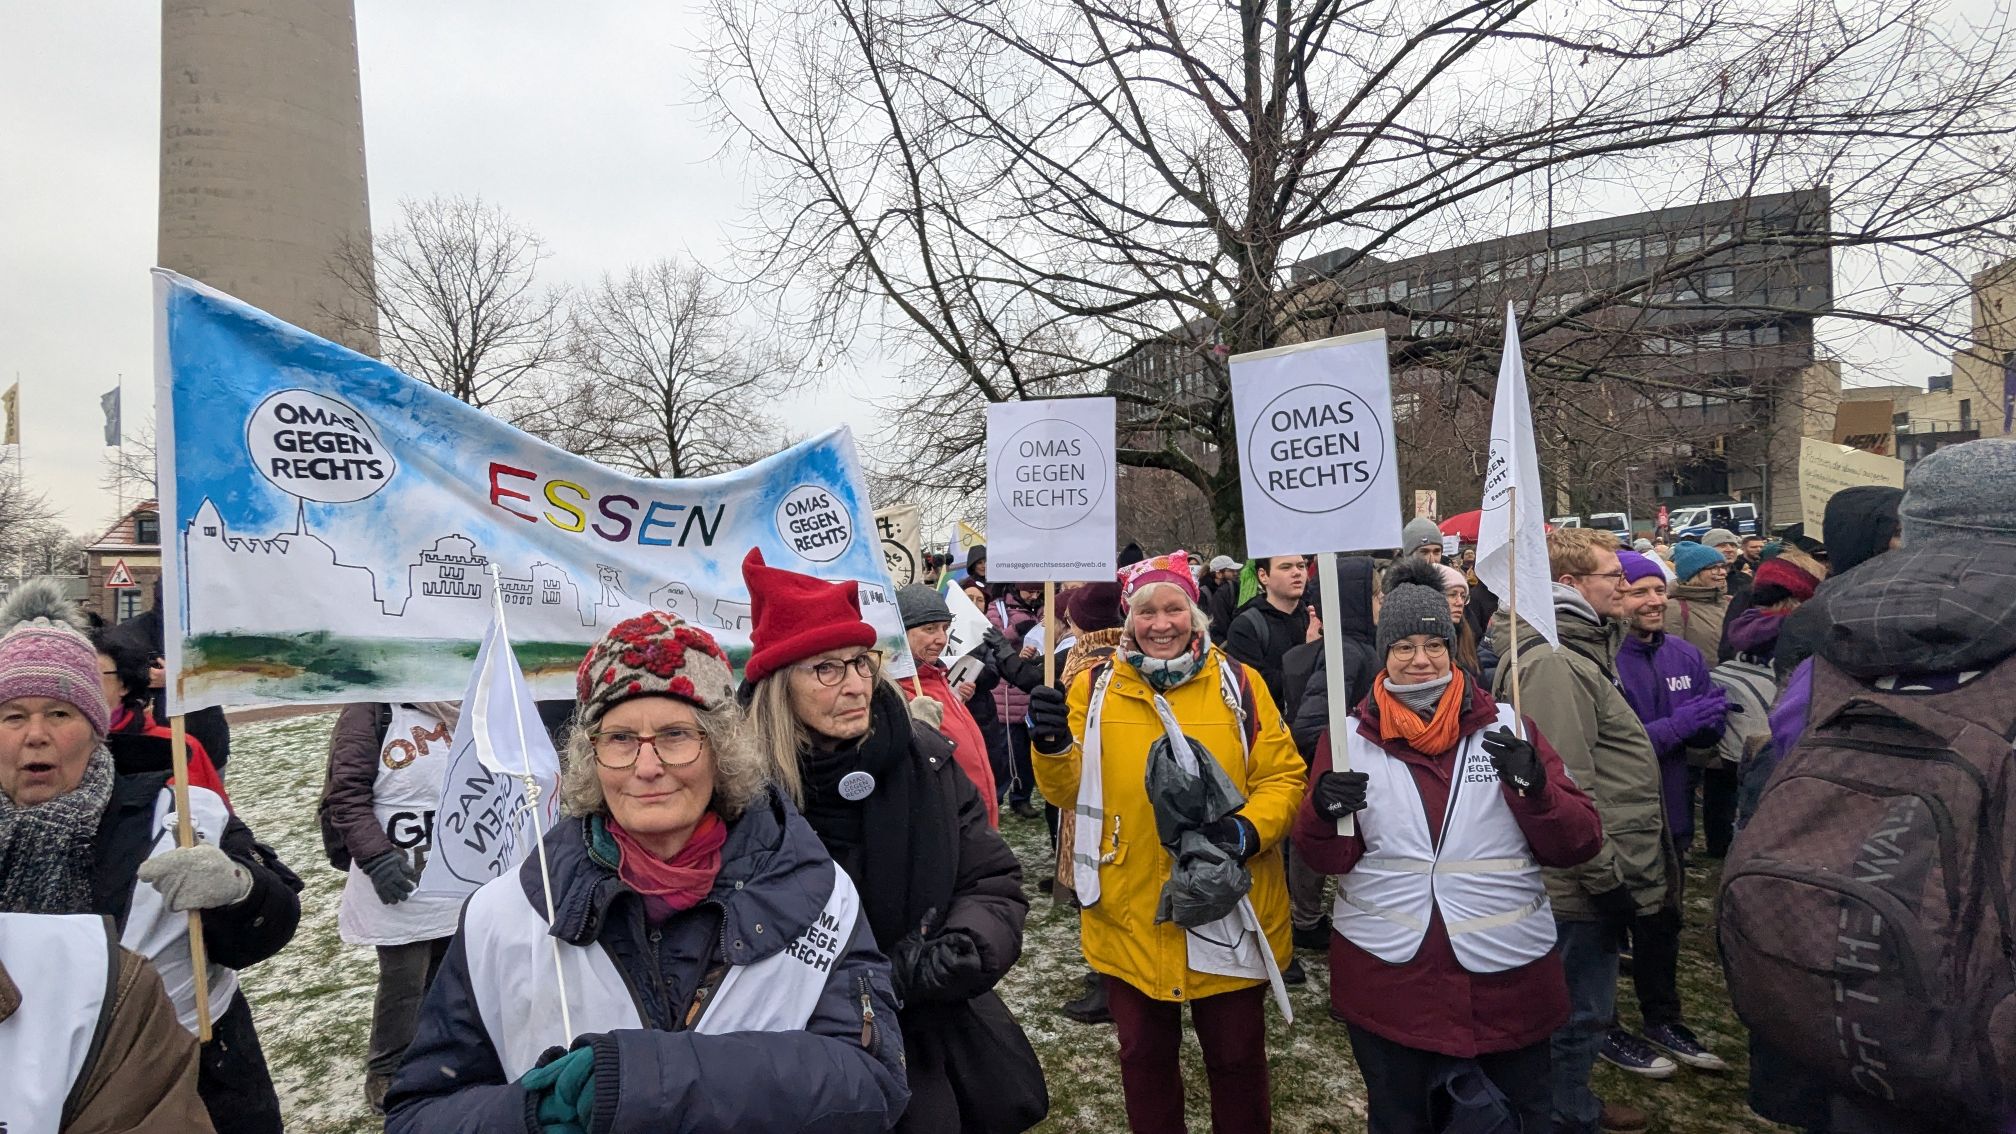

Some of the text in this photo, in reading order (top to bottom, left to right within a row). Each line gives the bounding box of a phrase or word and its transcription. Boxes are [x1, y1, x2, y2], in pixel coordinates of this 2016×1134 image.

[274, 402, 360, 434] OMAS
[1271, 401, 1354, 432] OMAS
[273, 429, 374, 455] GEGEN
[1019, 438, 1081, 458] OMAS
[1270, 431, 1360, 462] GEGEN
[271, 457, 385, 481] RECHTS
[1016, 463, 1085, 483] GEGEN
[1268, 460, 1370, 491] RECHTS
[1487, 457, 1506, 477] GEN
[1482, 467, 1509, 497] ECHT
[489, 462, 726, 547] ESSEN
[785, 494, 830, 517] OMAS
[1013, 488, 1089, 507] RECHTS
[1491, 488, 1508, 502] Esse
[789, 510, 841, 534] GEGEN
[794, 525, 848, 552] RECHTS
[995, 561, 1107, 570] omasgegenrechtsessen@web.de
[1665, 675, 1692, 691] Volt
[382, 721, 453, 770] OM
[1466, 765, 1497, 773] EGE
[1467, 755, 1493, 764] MA
[845, 780, 869, 792] GEGEN
[1465, 774, 1500, 783] ECHT
[846, 785, 872, 798] RECHTS
[819, 911, 840, 933] MA
[806, 926, 838, 956] EGE
[785, 940, 832, 973] RECH
